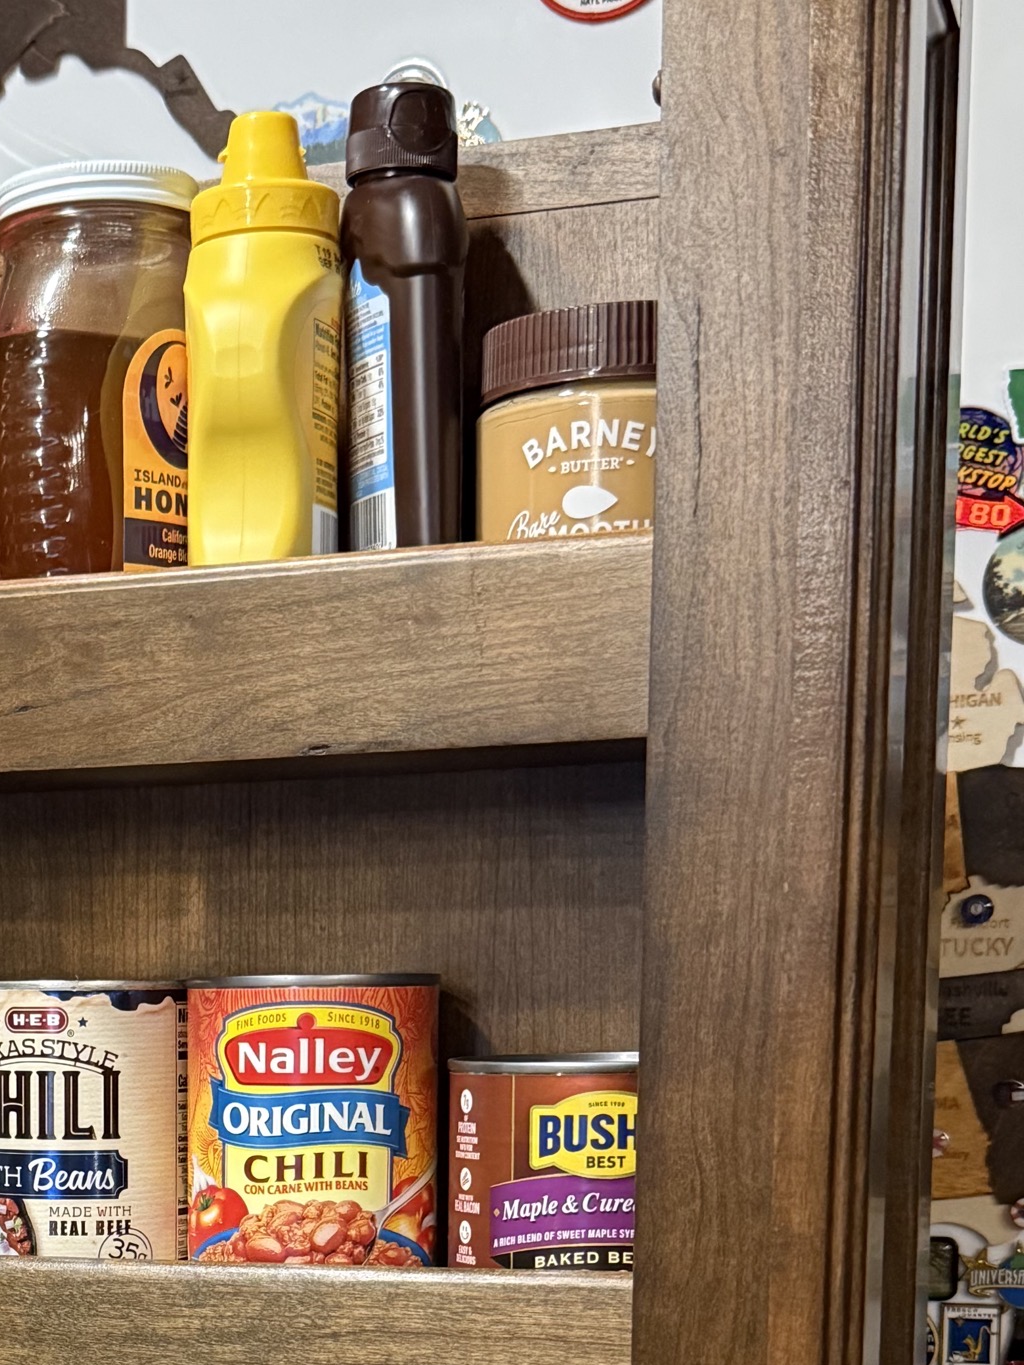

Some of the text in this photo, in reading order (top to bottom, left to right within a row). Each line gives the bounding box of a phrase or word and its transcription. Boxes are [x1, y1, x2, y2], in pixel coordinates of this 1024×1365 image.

[959, 421, 1010, 444] RLD'S
[560, 458, 621, 475] BUTTER
[134, 468, 181, 487] ISLAND
[957, 466, 1017, 491] KSTOP
[969, 503, 1011, 527] 80
[506, 510, 561, 541] Bare
[149, 544, 177, 561] Orange
[940, 937, 1014, 957] TUCKY
[236, 1012, 287, 1031] FINE FOODS
[327, 1011, 381, 1029] SINCE 1918
[40, 1038, 119, 1070] STYLE
[237, 1037, 383, 1081] Nalley
[222, 1101, 393, 1137] ORIGINAL
[243, 1151, 369, 1184] CHILI
[586, 1154, 627, 1169] BEST
[28, 1157, 115, 1192] Beans
[244, 1180, 369, 1195] CON CARNE WITH BEANS
[49, 1205, 133, 1218] MADE WITH
[502, 1194, 559, 1222] Maple
[561, 1193, 578, 1214] &
[48, 1219, 132, 1237] REAL BEEF
[493, 1228, 635, 1248] A RICH BLEND OF SWEET MAPLE SYR
[534, 1251, 634, 1269] BAKED BE
